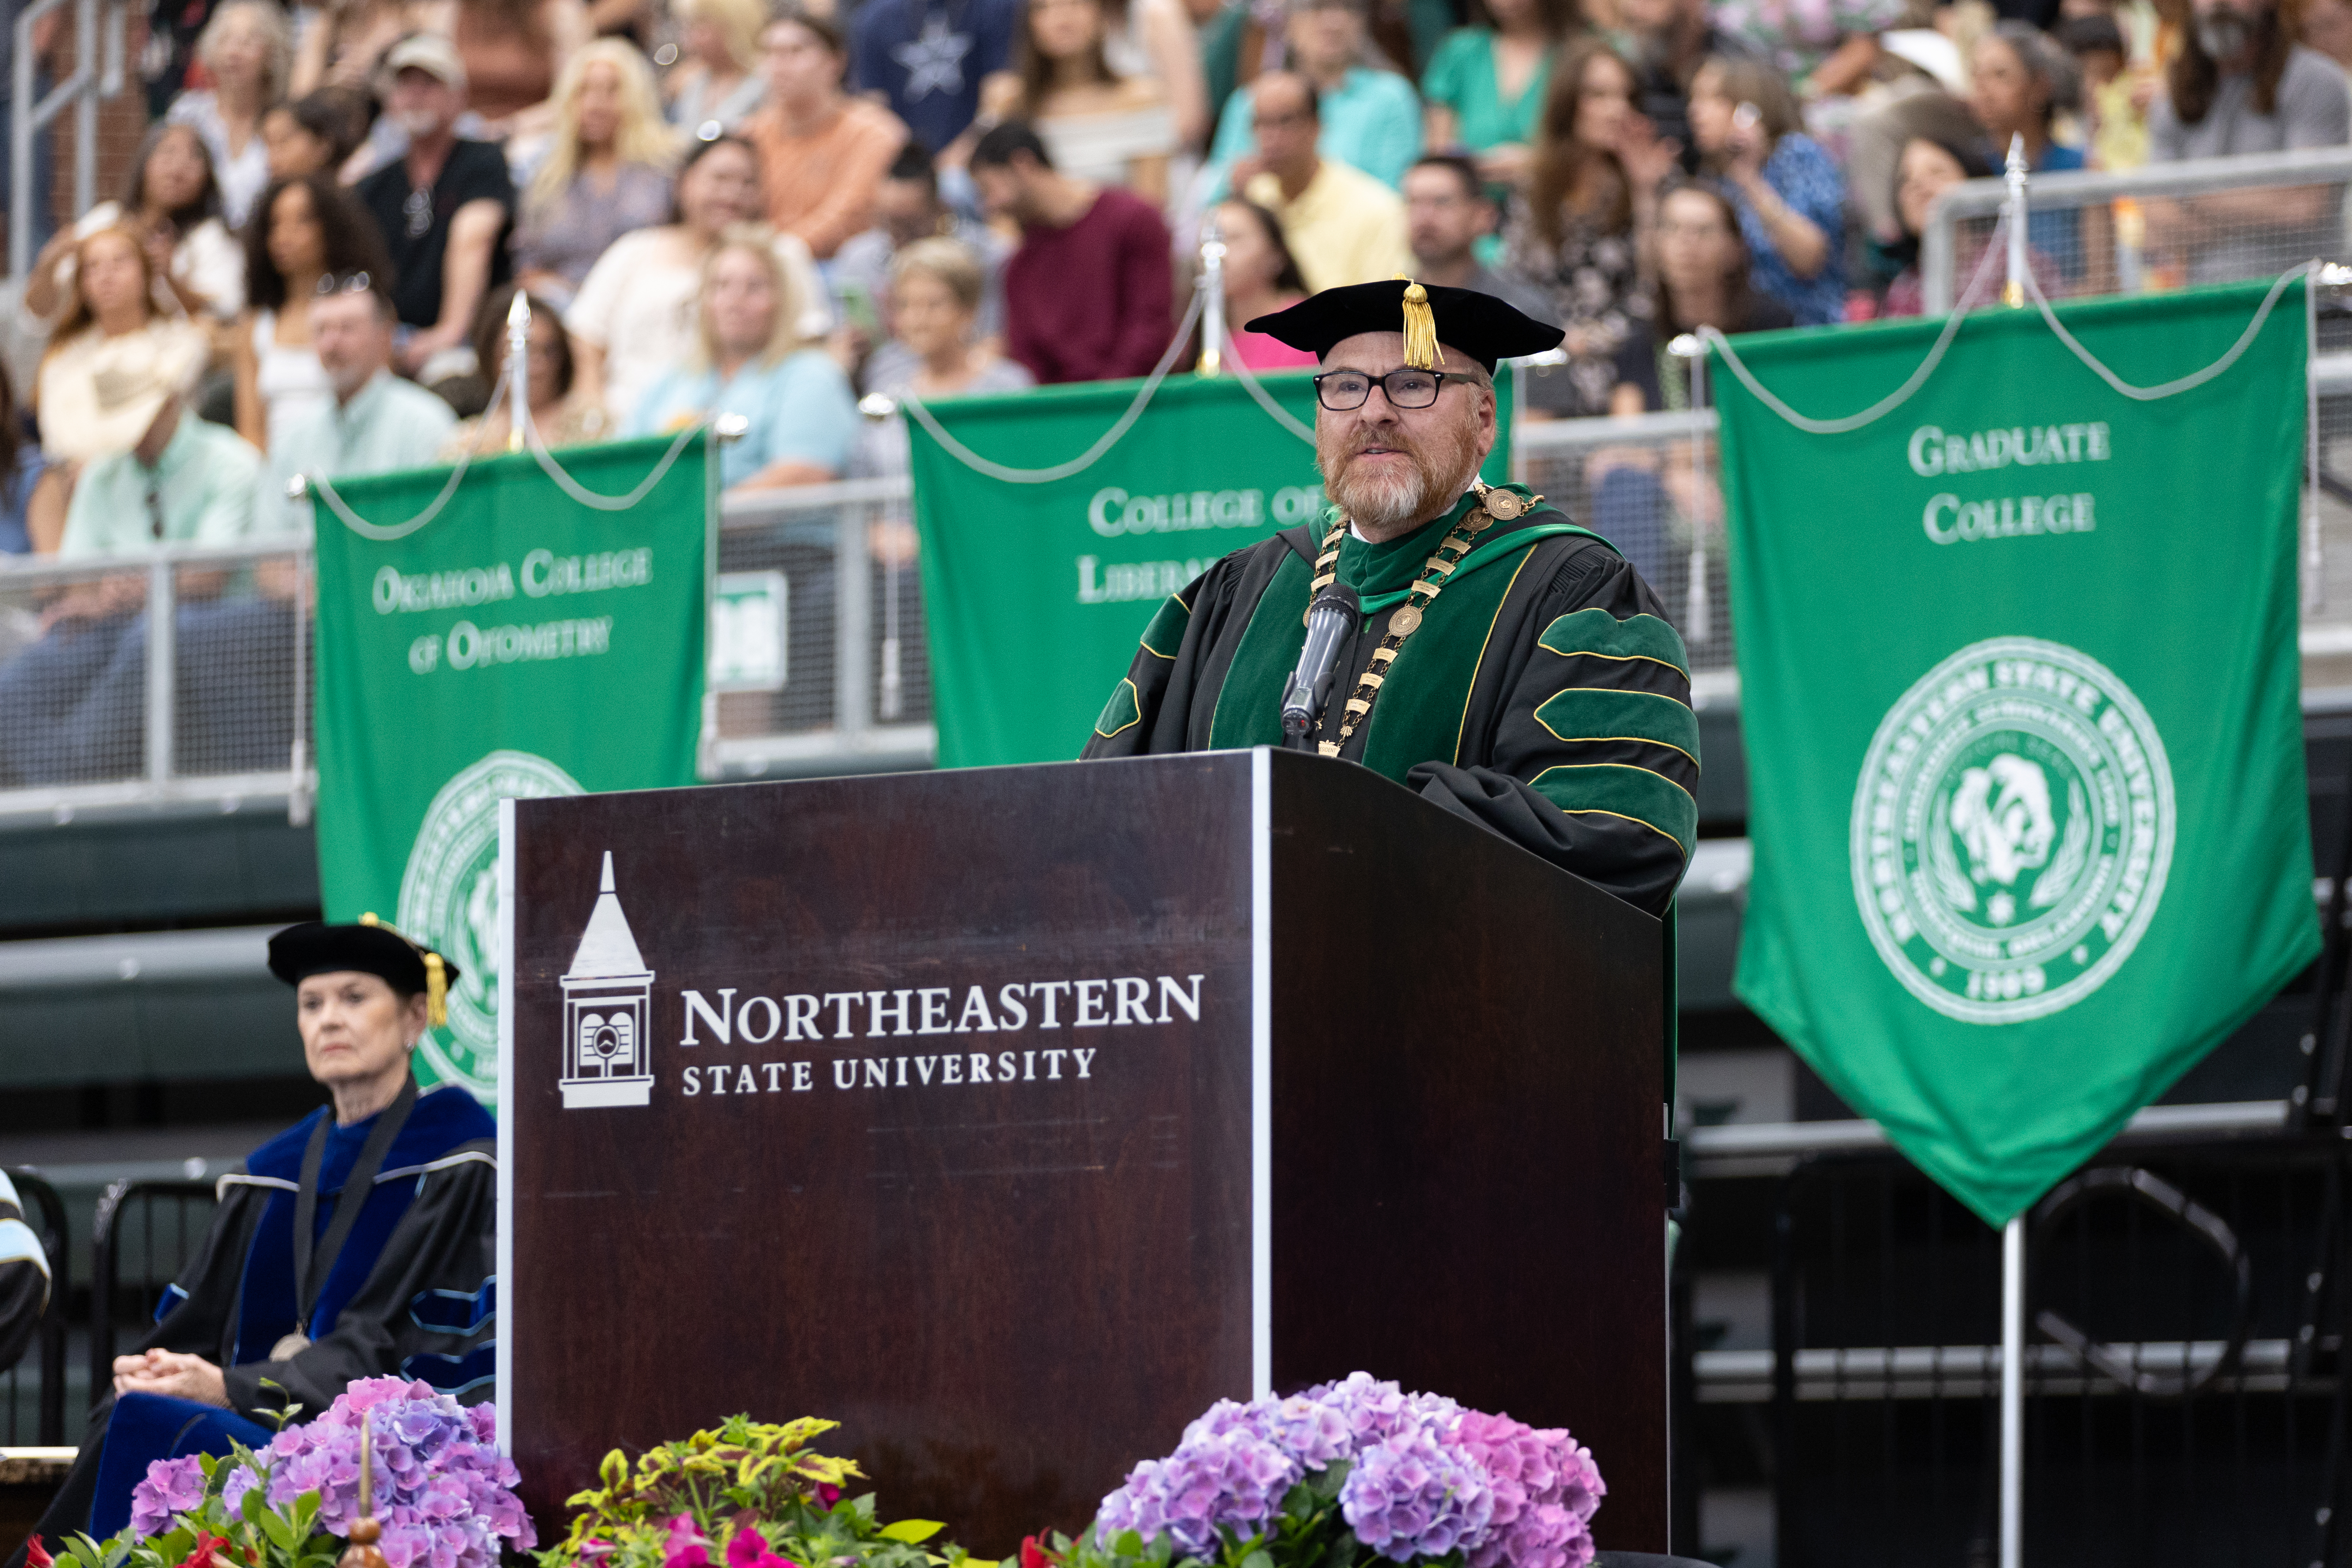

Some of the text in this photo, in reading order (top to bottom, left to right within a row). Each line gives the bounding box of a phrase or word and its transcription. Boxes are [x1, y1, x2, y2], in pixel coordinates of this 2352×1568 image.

[1908, 421, 2111, 477] GRADUATE
[1088, 486, 1265, 537] COLLEGE
[1922, 492, 2096, 545] COLLEGE
[680, 974, 1205, 1046] NORTHEASTERN
[682, 1048, 1096, 1096] STATE UNIVERSITY
